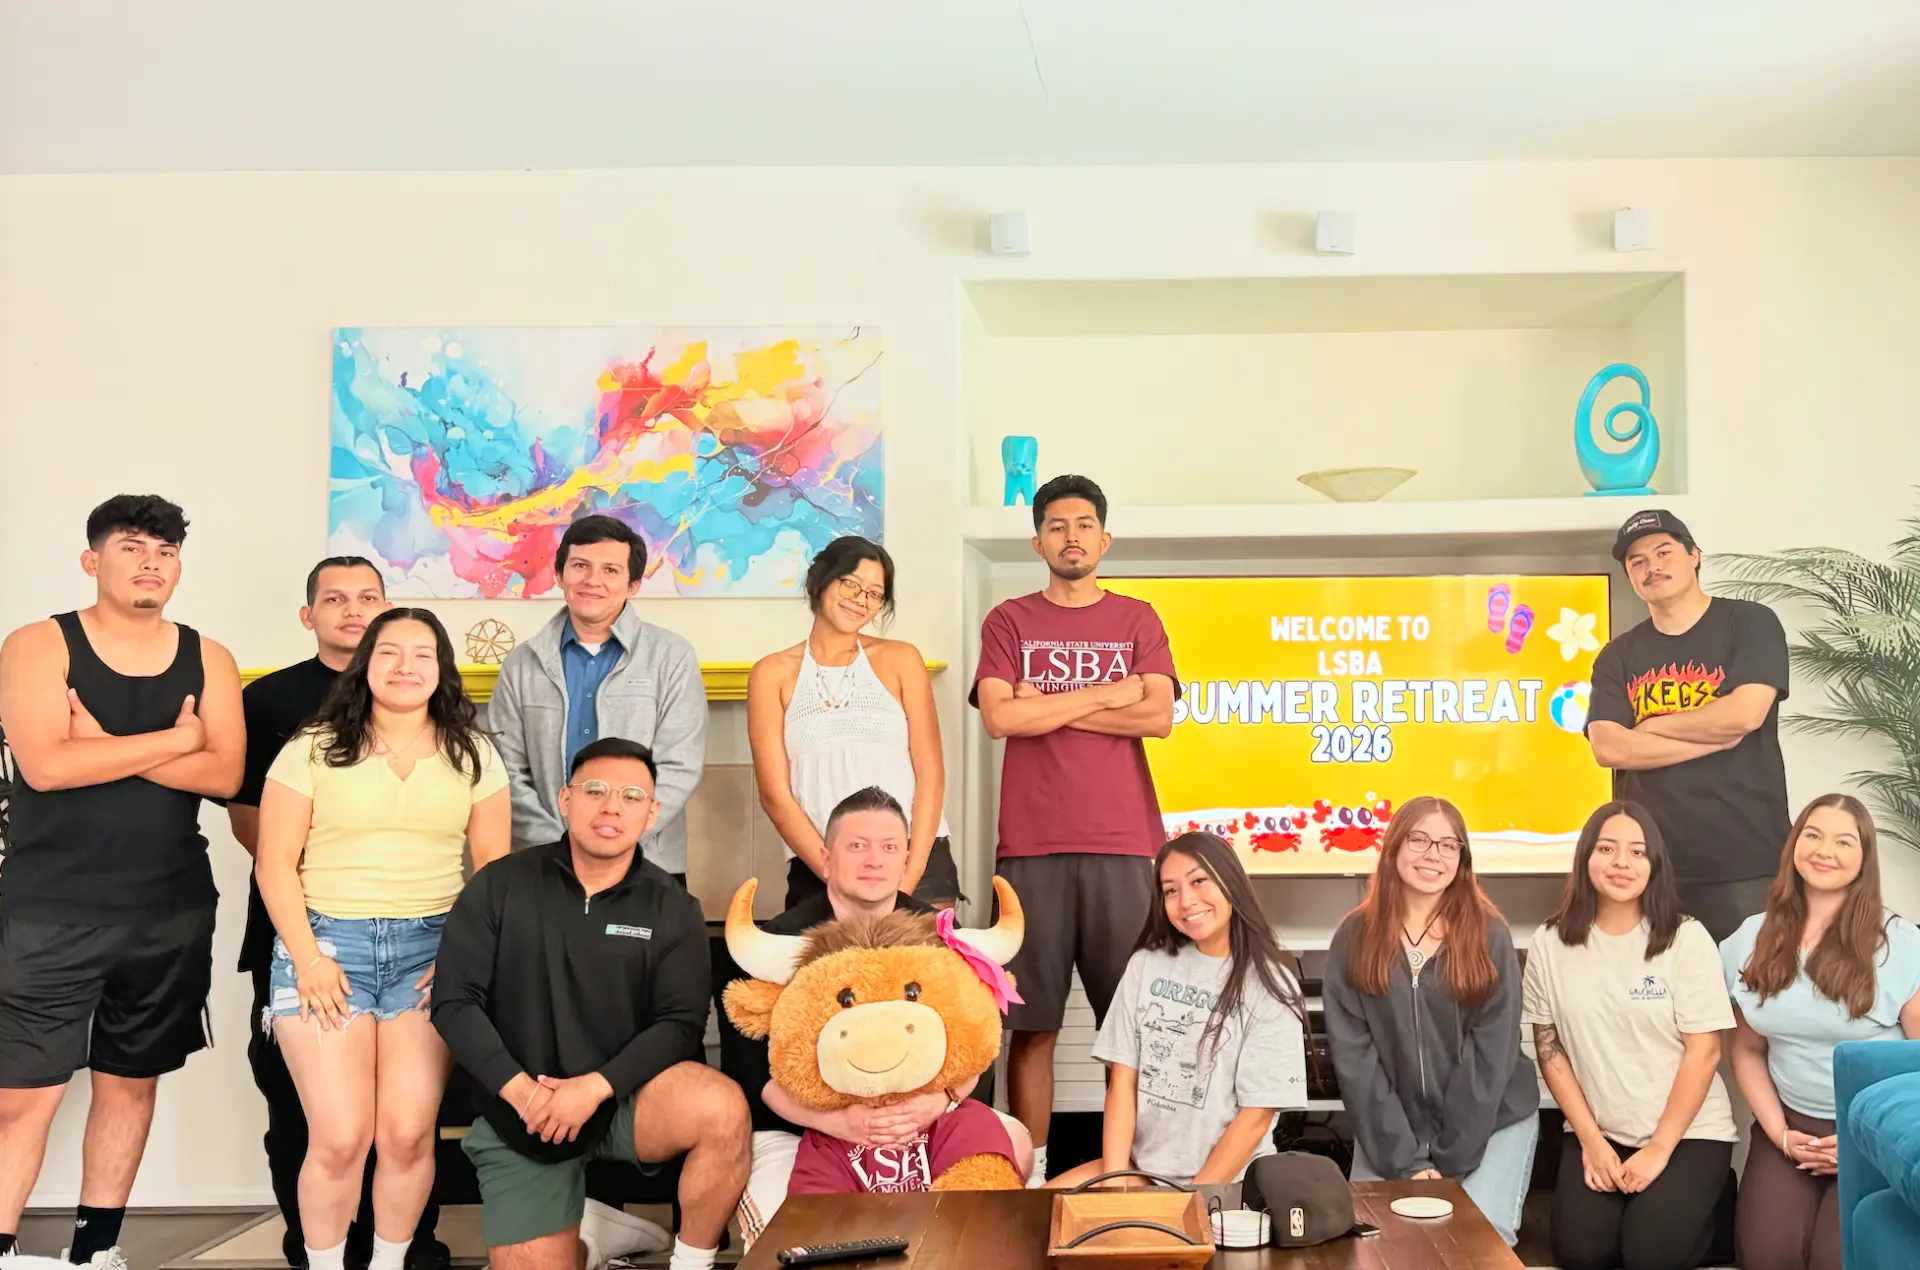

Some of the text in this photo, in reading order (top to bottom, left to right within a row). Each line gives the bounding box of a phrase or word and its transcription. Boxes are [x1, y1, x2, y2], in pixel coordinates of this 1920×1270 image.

[1020, 640, 1063, 648] CALIFORNIA
[1271, 616, 1430, 642] WELCOME TO
[1020, 648, 1129, 682] LSBA
[1318, 650, 1383, 676] LSBA
[1351, 679, 1543, 723] RETREAT
[1310, 724, 1393, 762] 2026
[607, 925, 651, 938] nterprise
[1149, 977, 1231, 1015] OREGO
